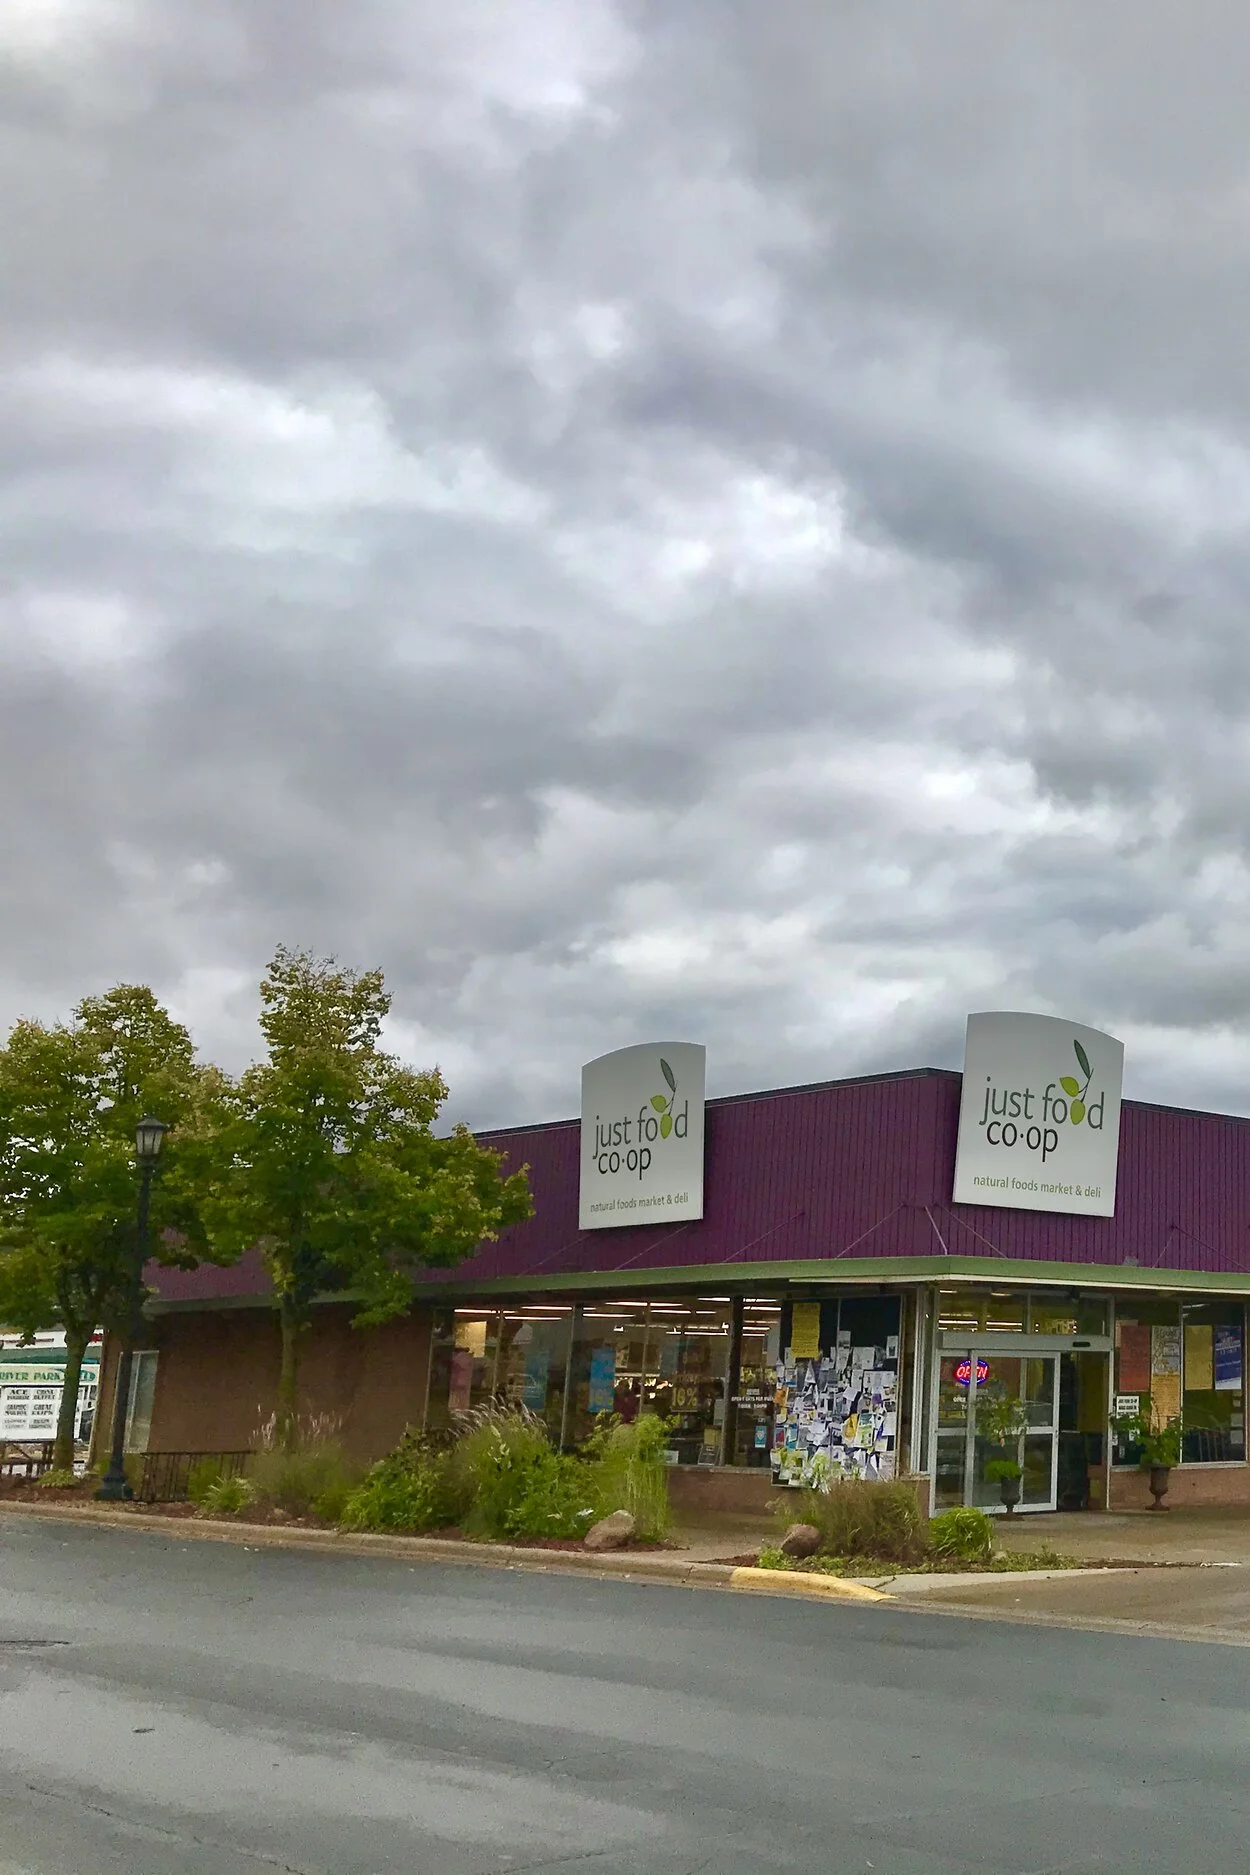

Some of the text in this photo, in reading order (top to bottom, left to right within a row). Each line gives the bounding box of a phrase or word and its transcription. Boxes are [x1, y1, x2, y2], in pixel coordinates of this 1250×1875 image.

[979, 1076, 1035, 1126] just
[592, 1115, 631, 1159] just
[973, 1175, 1101, 1198] natural foods market & deli
[590, 1199, 615, 1212] natural
[617, 1197, 637, 1210] foods
[638, 1195, 665, 1207] market
[674, 1192, 689, 1203] deli
[34, 1372, 60, 1380] PARK
